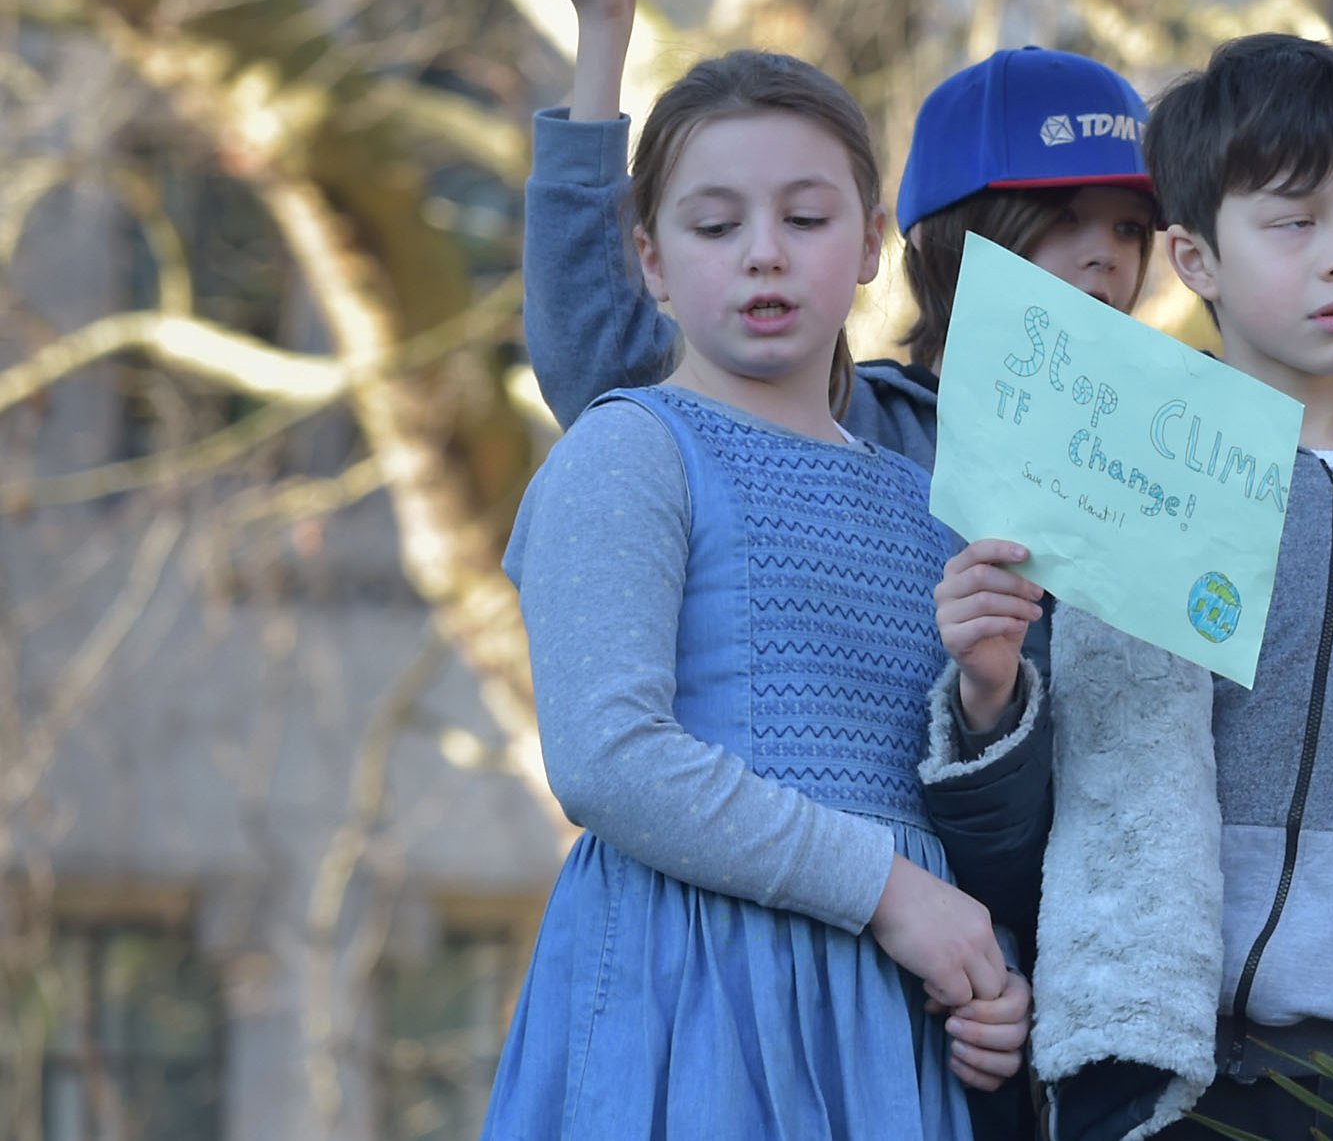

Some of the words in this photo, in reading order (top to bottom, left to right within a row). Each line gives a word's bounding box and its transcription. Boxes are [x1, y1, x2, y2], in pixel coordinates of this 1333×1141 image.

[1004, 306, 1118, 428] Stop
[1022, 461, 1042, 487] Save
[1051, 479, 1069, 499] Our
[1068, 428, 1196, 532] Change!
